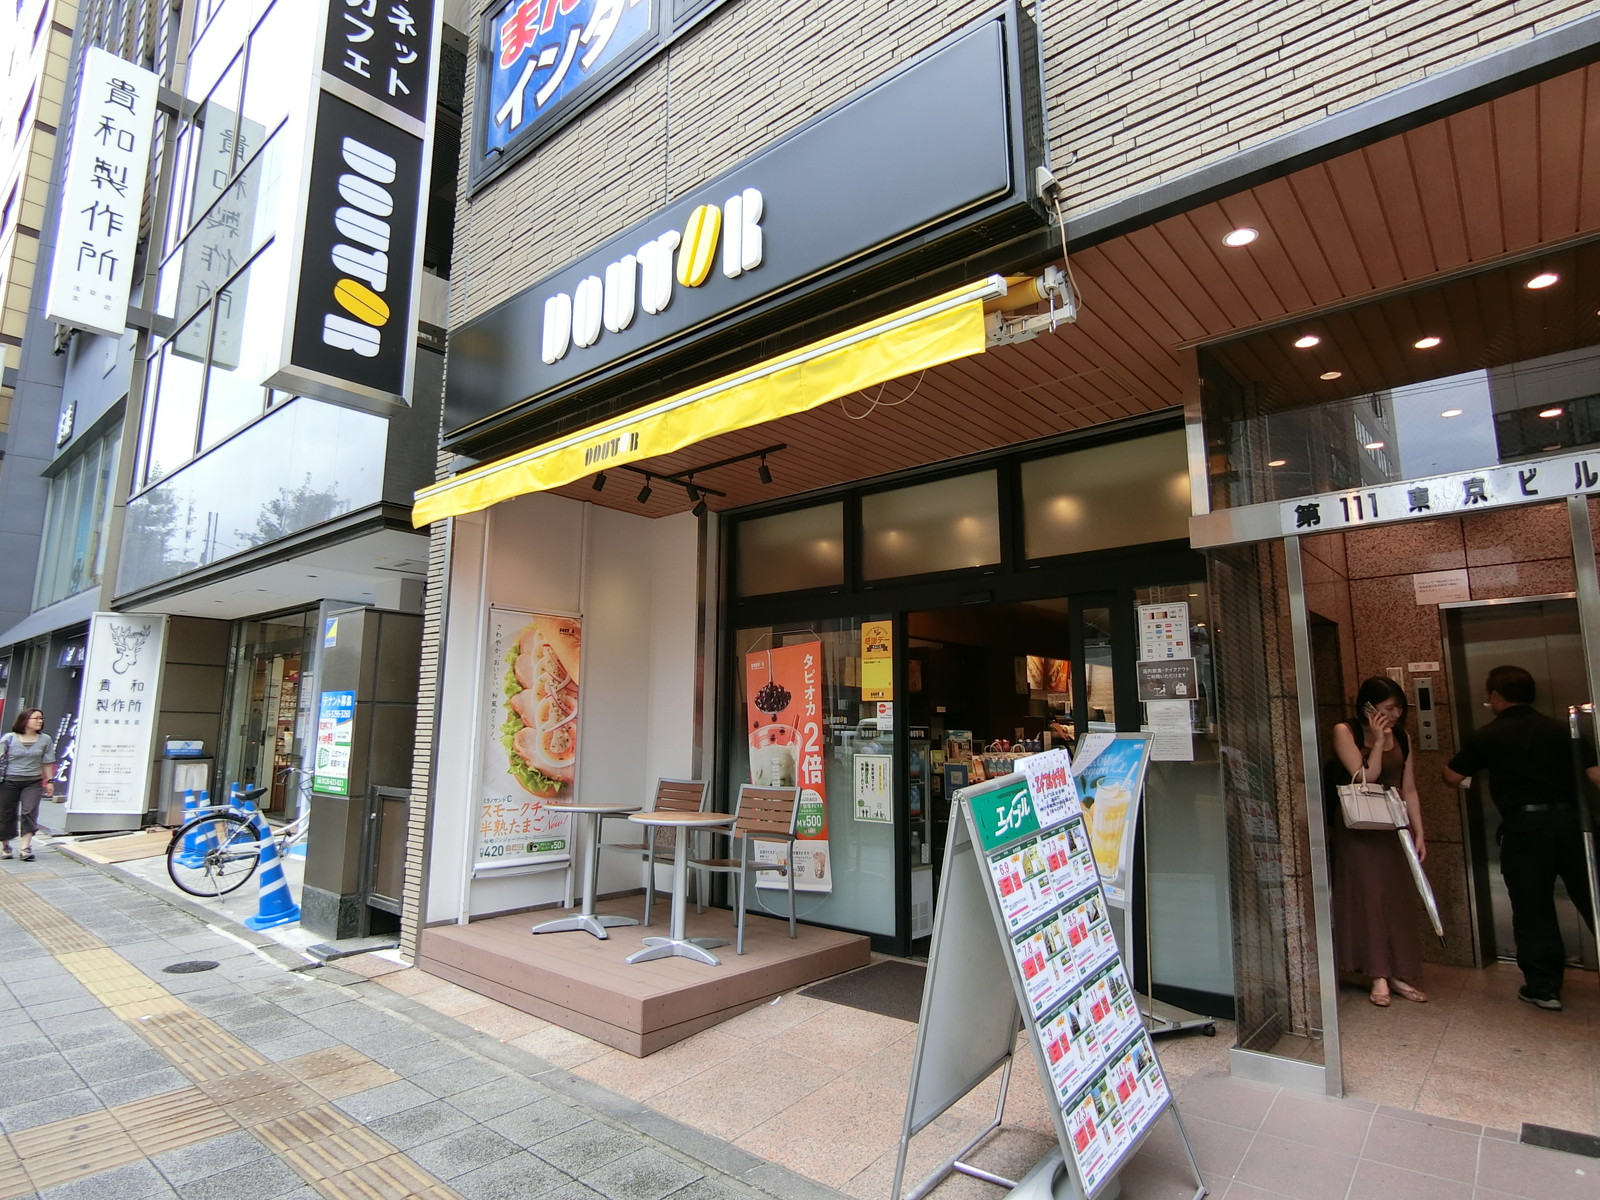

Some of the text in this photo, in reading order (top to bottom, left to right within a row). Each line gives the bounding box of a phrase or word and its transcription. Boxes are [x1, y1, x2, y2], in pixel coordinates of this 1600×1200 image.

[387, 0, 418, 97] ネット
[496, 0, 642, 131] インタ
[76, 78, 140, 282] 貴和製作所
[322, 136, 397, 358] DOUTOR
[541, 187, 764, 365] DOUTOR
[584, 432, 639, 466] DOUTOR
[95, 698, 142, 713] 製作所
[480, 816, 545, 838] 半熟たまご
[995, 789, 1031, 837] エイブル
